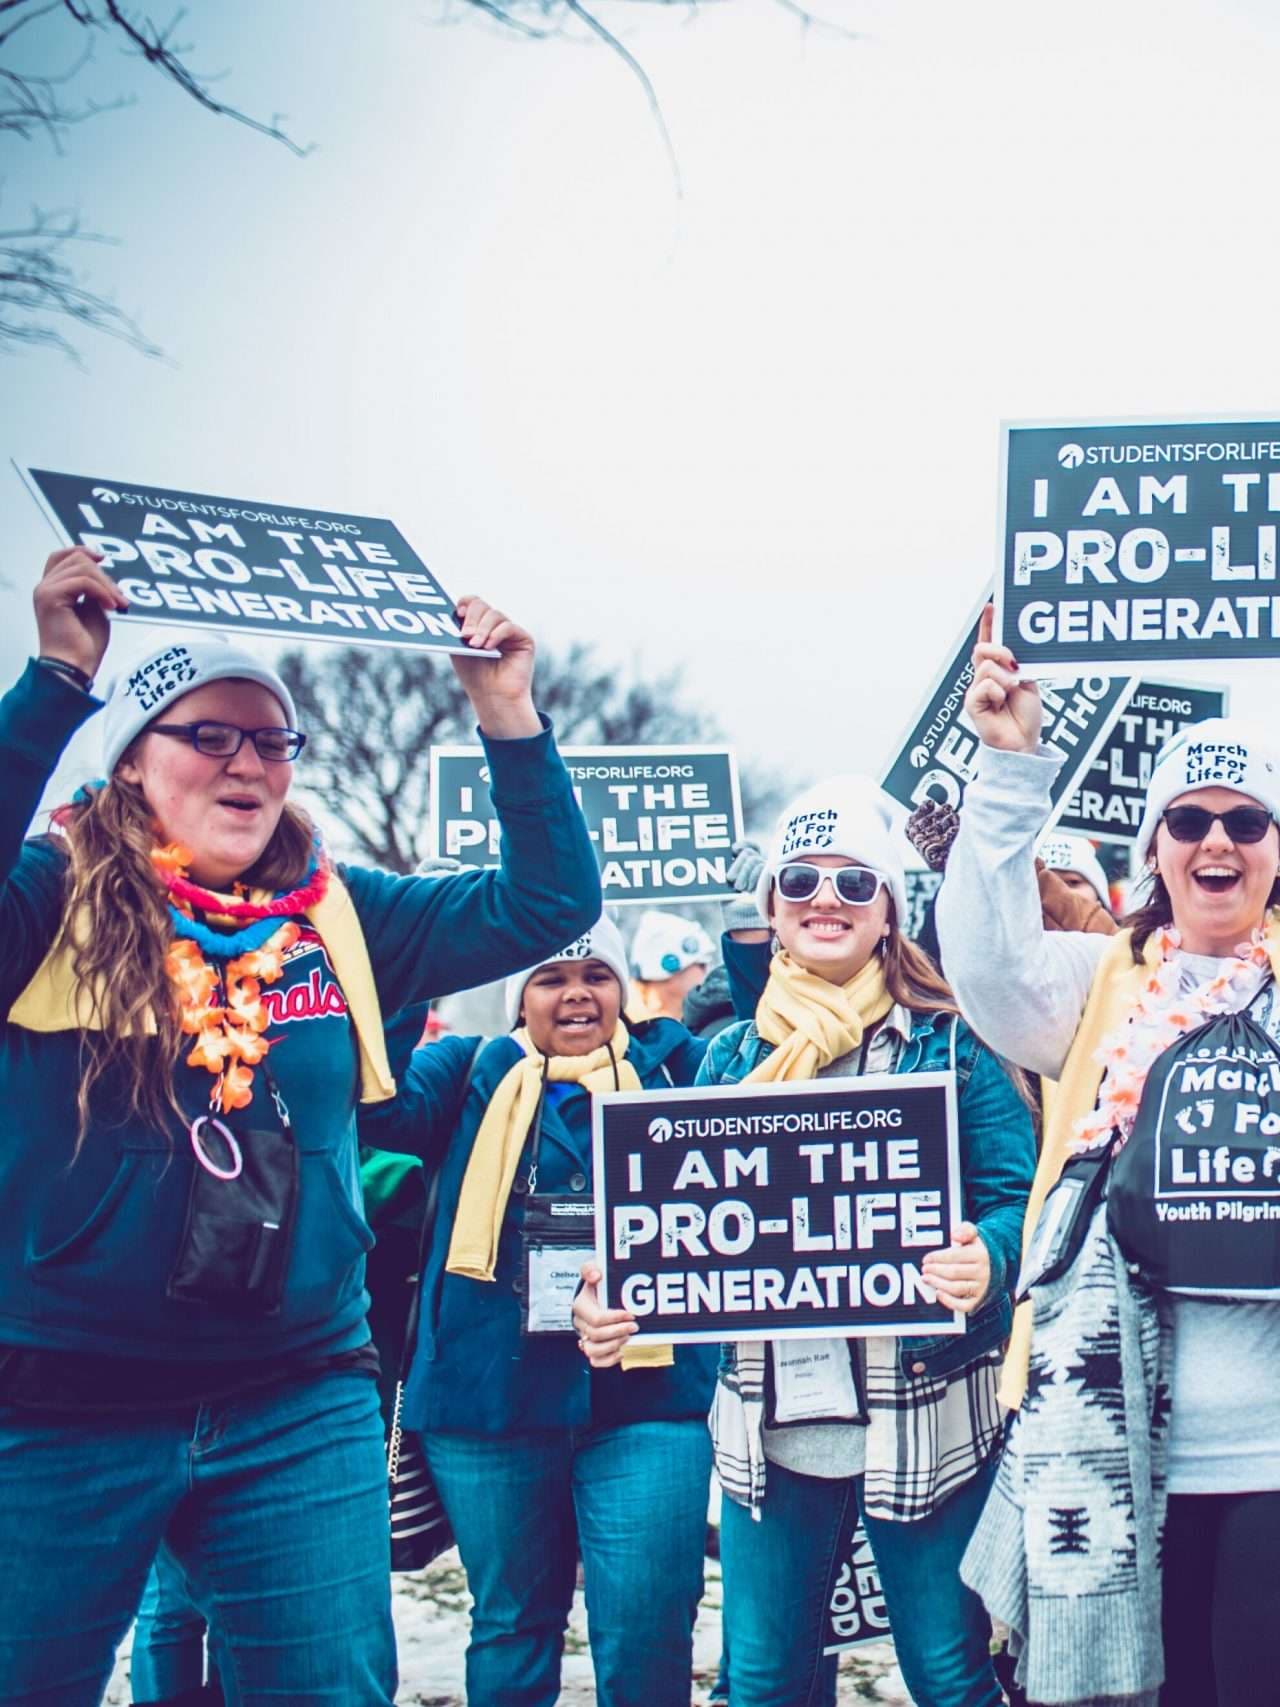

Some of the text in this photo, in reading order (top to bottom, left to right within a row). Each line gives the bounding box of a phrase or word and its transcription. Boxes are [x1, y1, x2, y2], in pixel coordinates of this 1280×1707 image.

[1034, 479, 1048, 518] I
[1082, 475, 1187, 517] AM
[121, 492, 362, 536] STUDENTSFORLIFE.ORG
[78, 503, 399, 566] I AM THE
[79, 532, 448, 606] PRO-LIFE
[116, 577, 463, 638] GENERATION
[128, 646, 188, 689] March
[157, 657, 192, 681] For
[139, 680, 177, 711] Life
[1187, 742, 1248, 758] March
[1215, 755, 1247, 771] For
[1187, 767, 1224, 784] Life
[461, 786, 473, 813] I
[608, 783, 710, 811] THE
[787, 809, 838, 830] March
[805, 822, 836, 834] For
[782, 836, 812, 855] Life
[673, 1108, 902, 1139] STUDENTSFORLIFE.ORG
[628, 1138, 921, 1193] I AM THE
[1171, 1145, 1257, 1185] Life
[613, 1190, 944, 1260] PRO-LIFE
[1155, 1202, 1212, 1222] Youth
[621, 1261, 938, 1317] GENERATION
